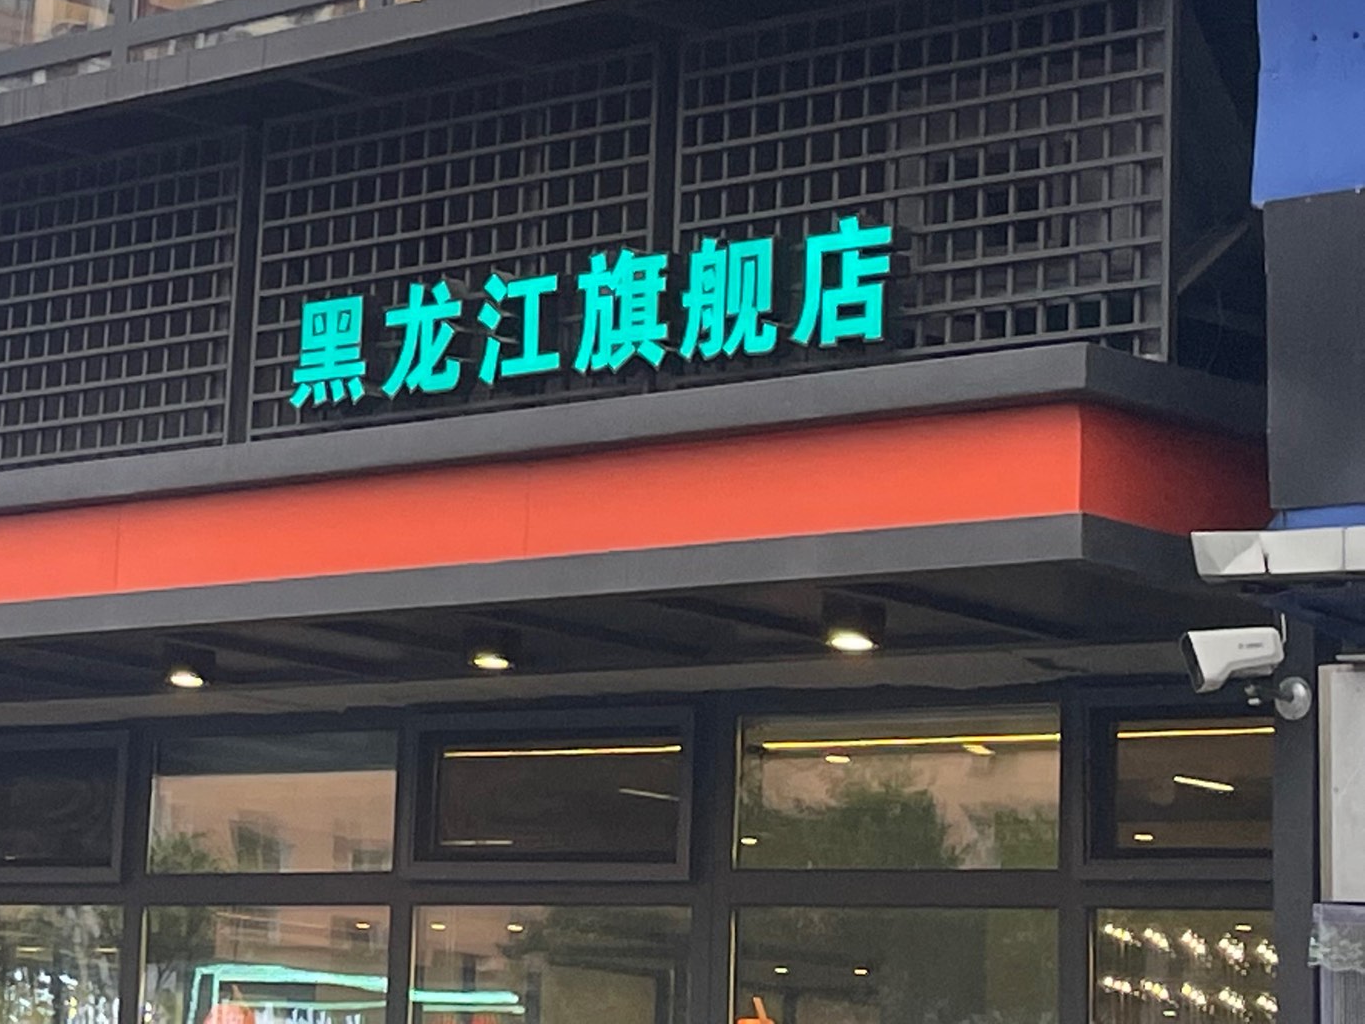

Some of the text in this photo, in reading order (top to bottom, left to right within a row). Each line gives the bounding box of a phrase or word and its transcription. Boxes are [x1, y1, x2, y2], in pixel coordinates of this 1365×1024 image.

[289, 216, 892, 407] 黑龙江旗舰店
